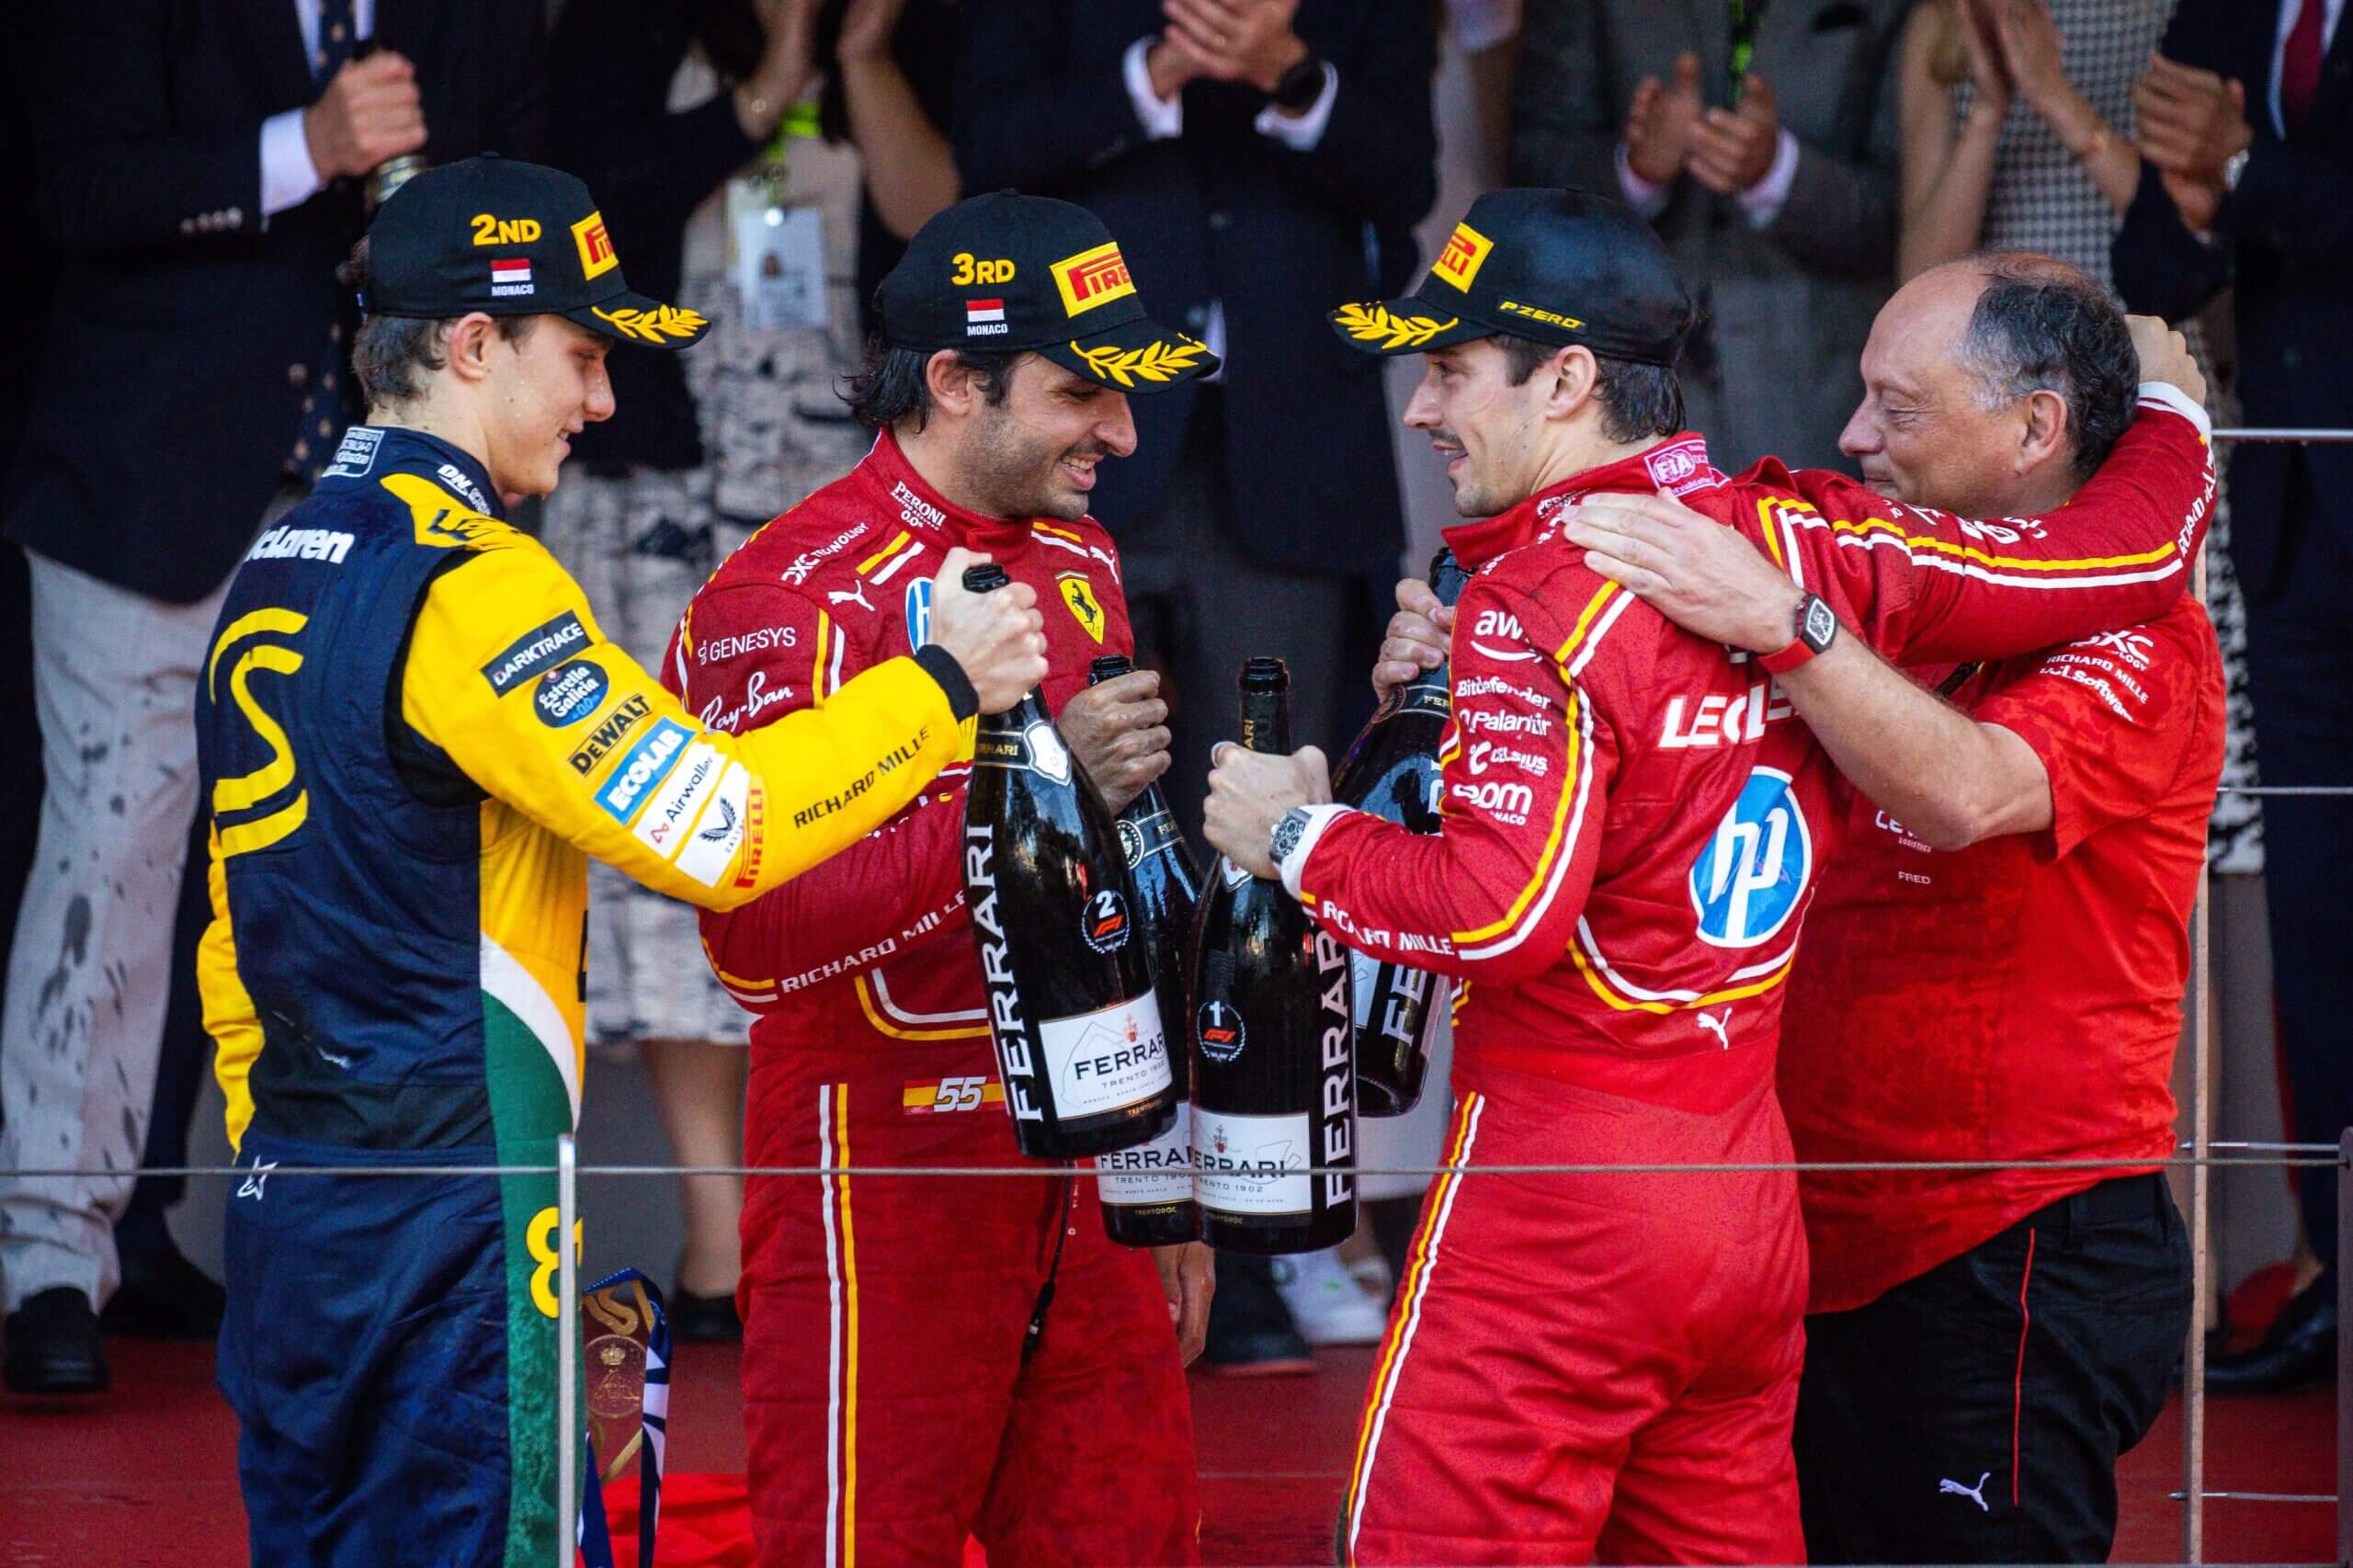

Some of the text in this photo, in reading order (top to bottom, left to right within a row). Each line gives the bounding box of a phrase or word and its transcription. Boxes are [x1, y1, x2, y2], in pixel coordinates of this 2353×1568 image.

[471, 213, 542, 246] 2ND
[951, 253, 1016, 286] 3RD
[492, 284, 534, 296] MONACO
[967, 324, 1008, 336] MONACO
[1655, 454, 1693, 481] FIA
[892, 481, 947, 527] PERONI
[810, 521, 870, 558] TNOLGY
[710, 627, 796, 662] GENESYS
[1474, 609, 1531, 644] aw
[493, 621, 585, 687] DARKTRACE
[539, 666, 591, 710] Estrella
[551, 678, 600, 717] Galicia
[1455, 676, 1552, 710] Bitdefender
[2046, 653, 2114, 673] RICHARD
[2115, 669, 2149, 706] MILLE
[699, 671, 794, 734] Ray-Ban
[1472, 709, 1552, 736] Palantir
[606, 729, 684, 812] ECOLAB
[793, 769, 875, 830] RICHARD
[877, 726, 931, 776] MILLE
[734, 789, 764, 889] PIRELLI
[1707, 801, 1790, 940] hp
[1898, 870, 1931, 884] FRED
[1399, 931, 1456, 956] MILLE
[781, 937, 897, 994] RICHARD
[966, 824, 1044, 1122] FERRARI
[933, 1075, 987, 1113] 55
[1101, 1070, 1148, 1089] TRENTO
[1114, 1176, 1159, 1184] TRENTO
[1235, 1185, 1264, 1193] 1902
